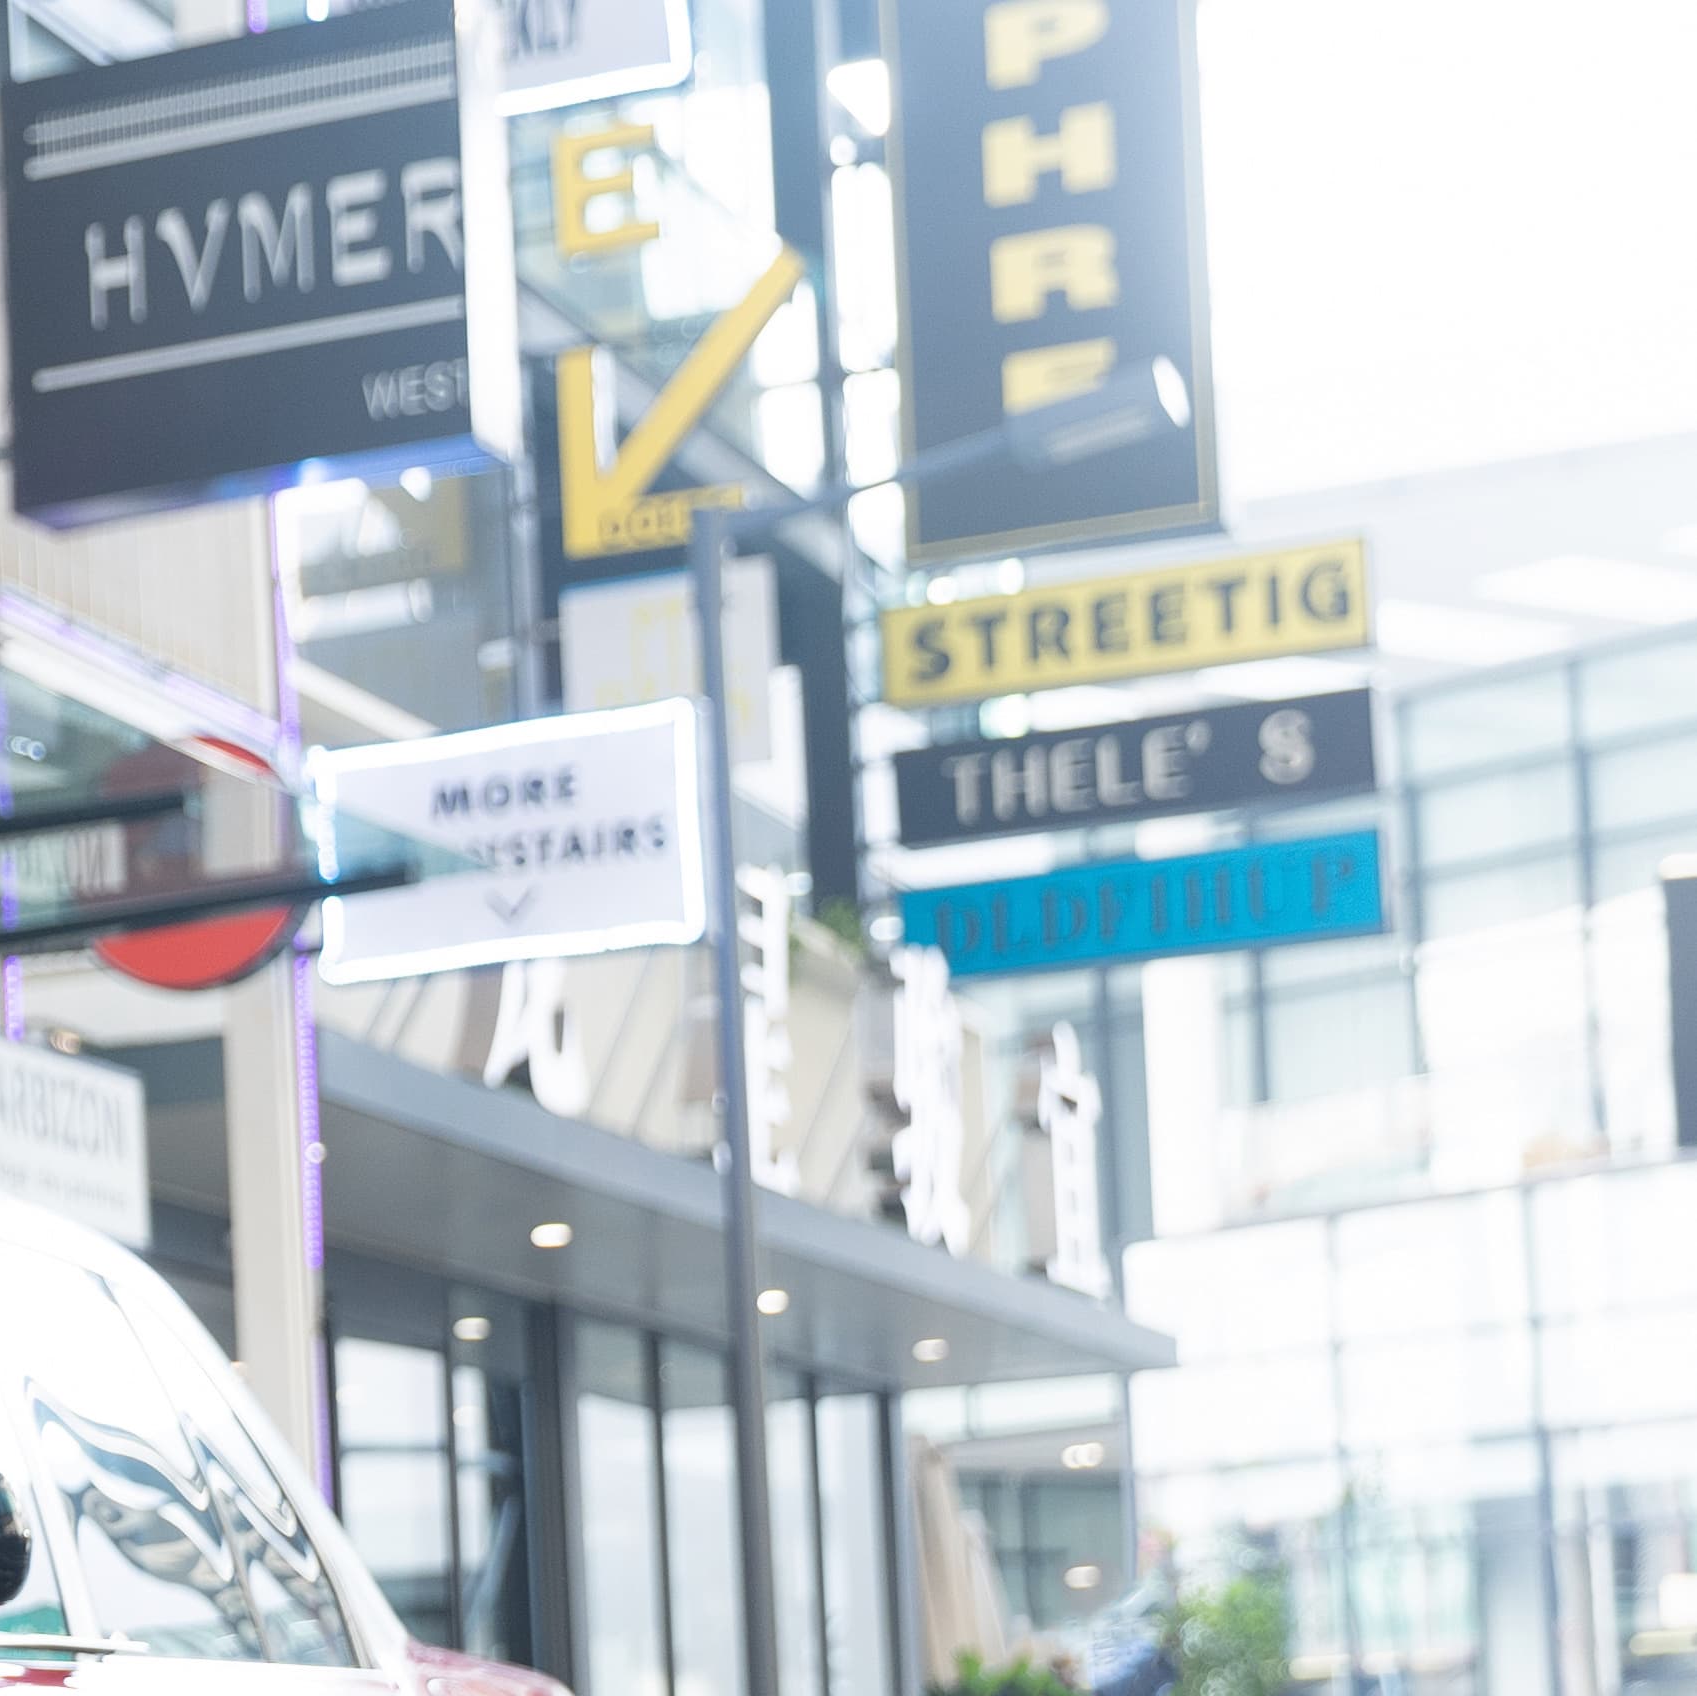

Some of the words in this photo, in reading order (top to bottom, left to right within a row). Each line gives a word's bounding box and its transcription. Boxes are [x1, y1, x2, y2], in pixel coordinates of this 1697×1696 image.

[85, 157, 462, 332] HVMER
[911, 560, 1352, 684] STREETIG
[431, 765, 578, 821] MORE
[467, 815, 666, 868] STAIRS
